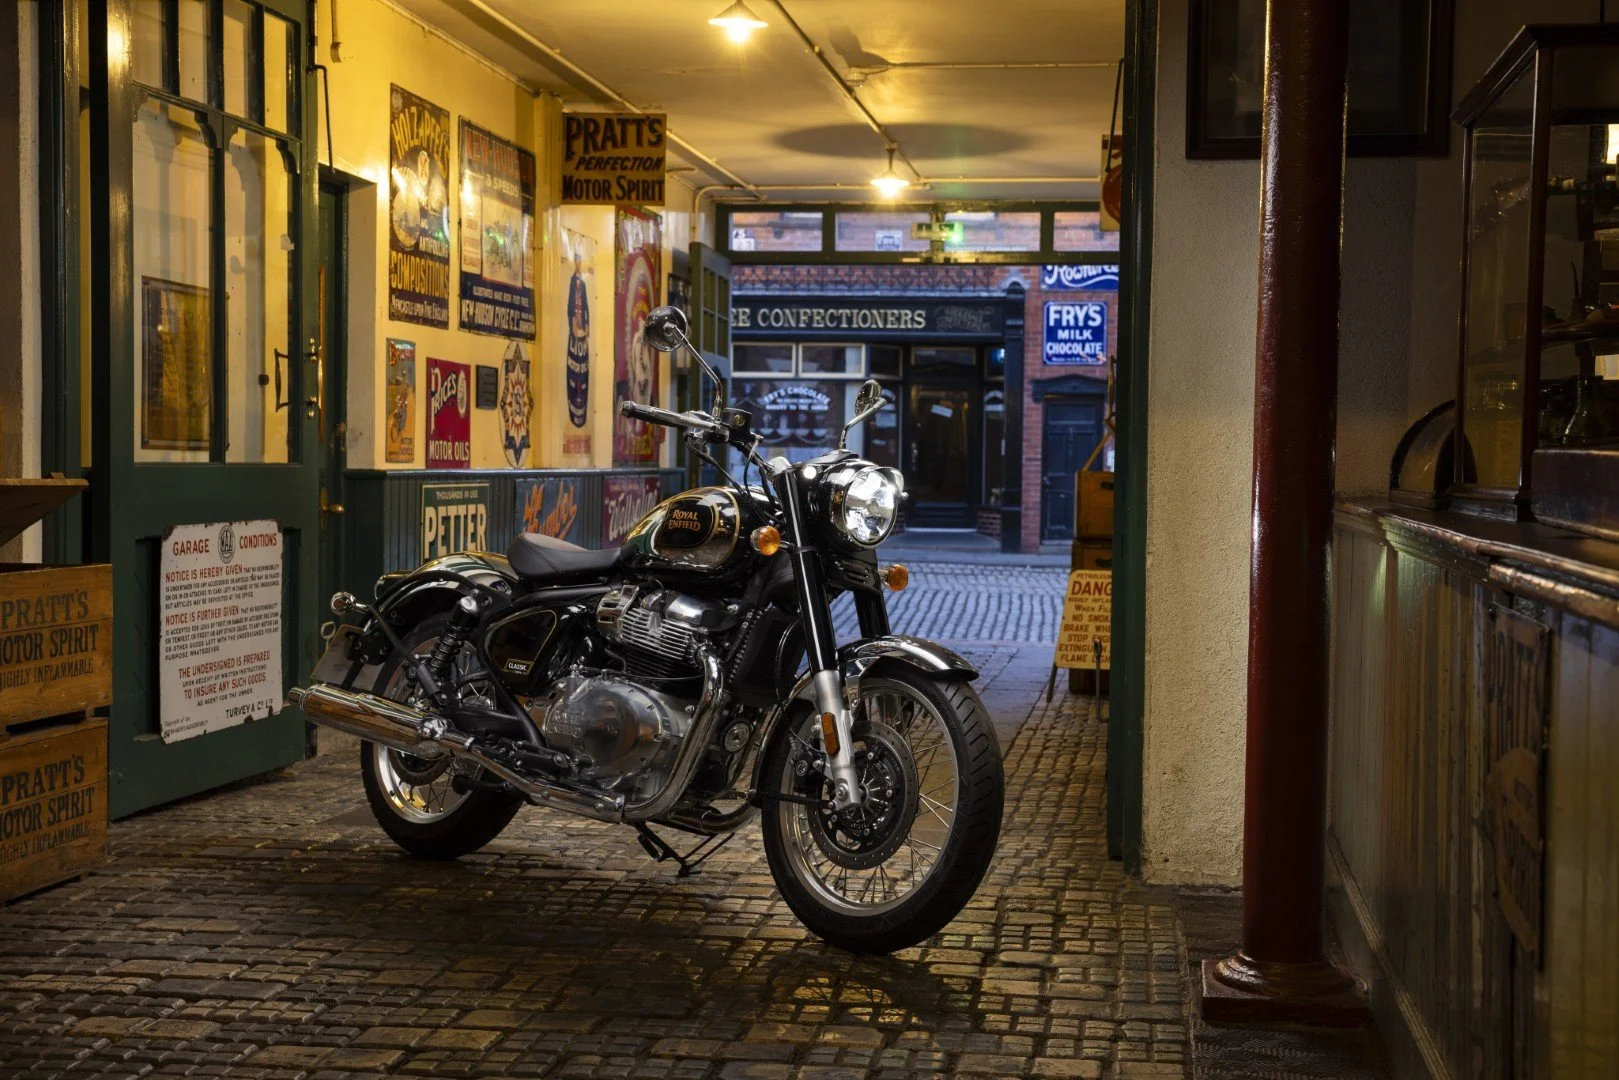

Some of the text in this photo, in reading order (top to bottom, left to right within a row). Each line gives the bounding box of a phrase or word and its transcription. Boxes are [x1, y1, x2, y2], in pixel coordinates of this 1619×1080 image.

[565, 116, 663, 161] PRATT'S
[575, 155, 663, 172] PERFECTION
[494, 177, 519, 197] SPEEDS
[563, 175, 664, 201] MOTOR SPIRIT
[391, 250, 449, 299] COMPOSITIONS
[757, 308, 926, 329] CONFECTIONERS
[1048, 303, 1102, 327] FRY'S
[1057, 329, 1093, 340] MILK
[1046, 342, 1103, 355] CHOCOLATE
[429, 440, 469, 461] MOTOR OILS
[436, 490, 478, 500] THOUSANDS IN USE
[672, 509, 698, 520] ROYAL
[424, 503, 487, 559] PETTER
[668, 520, 701, 532] ENFIELD
[173, 533, 278, 556] GARAGE CONDITIONS
[166, 570, 190, 583] NOTICE
[191, 569, 198, 580] IS
[200, 566, 224, 578] HEREBY
[226, 564, 243, 575] GIVEN
[171, 584, 193, 593] UNDERTAKEN
[190, 590, 207, 598] ATTACHED
[1, 588, 89, 630] PRATT'S
[174, 600, 193, 609] ARTICLES
[208, 595, 228, 603] DEPOSITED
[166, 613, 188, 627] NOTICE
[190, 612, 196, 622] IS
[198, 607, 222, 621] FURTHER
[223, 604, 239, 616] GIVEN
[1072, 614, 1083, 622] NO
[165, 638, 172, 646] OR
[224, 626, 236, 634] OTHER
[171, 626, 191, 636] ACCEPTED
[1063, 624, 1090, 632] BRAKE
[1067, 634, 1088, 642] STOP
[50, 623, 99, 659] SPIRIT
[174, 643, 188, 653] OTHER
[190, 640, 204, 649] GOODS
[206, 638, 216, 646] LEFT
[218, 636, 227, 644] WITH
[237, 628, 264, 640] UNDERSIGNED
[166, 652, 188, 662] PURPOSE
[179, 649, 271, 680] THE UNDERSIGNED IS PREPARED
[508, 662, 527, 671] CLASSIC
[1060, 654, 1088, 663] FLAME
[33, 657, 94, 682] INFLAMMABLE
[183, 680, 195, 689] UPON
[221, 670, 239, 679] WRITTEN
[240, 663, 267, 675] INSTRUCTIONS
[184, 671, 266, 701] TO INSURE ANY SUCH GOODS
[205, 697, 217, 706] AGENT
[219, 694, 228, 702] FOR
[225, 702, 255, 720] TURVEY &
[1, 754, 84, 805] PRATT'S
[47, 787, 95, 828] SPIRIT
[33, 822, 90, 852] INFLAMMABLE
